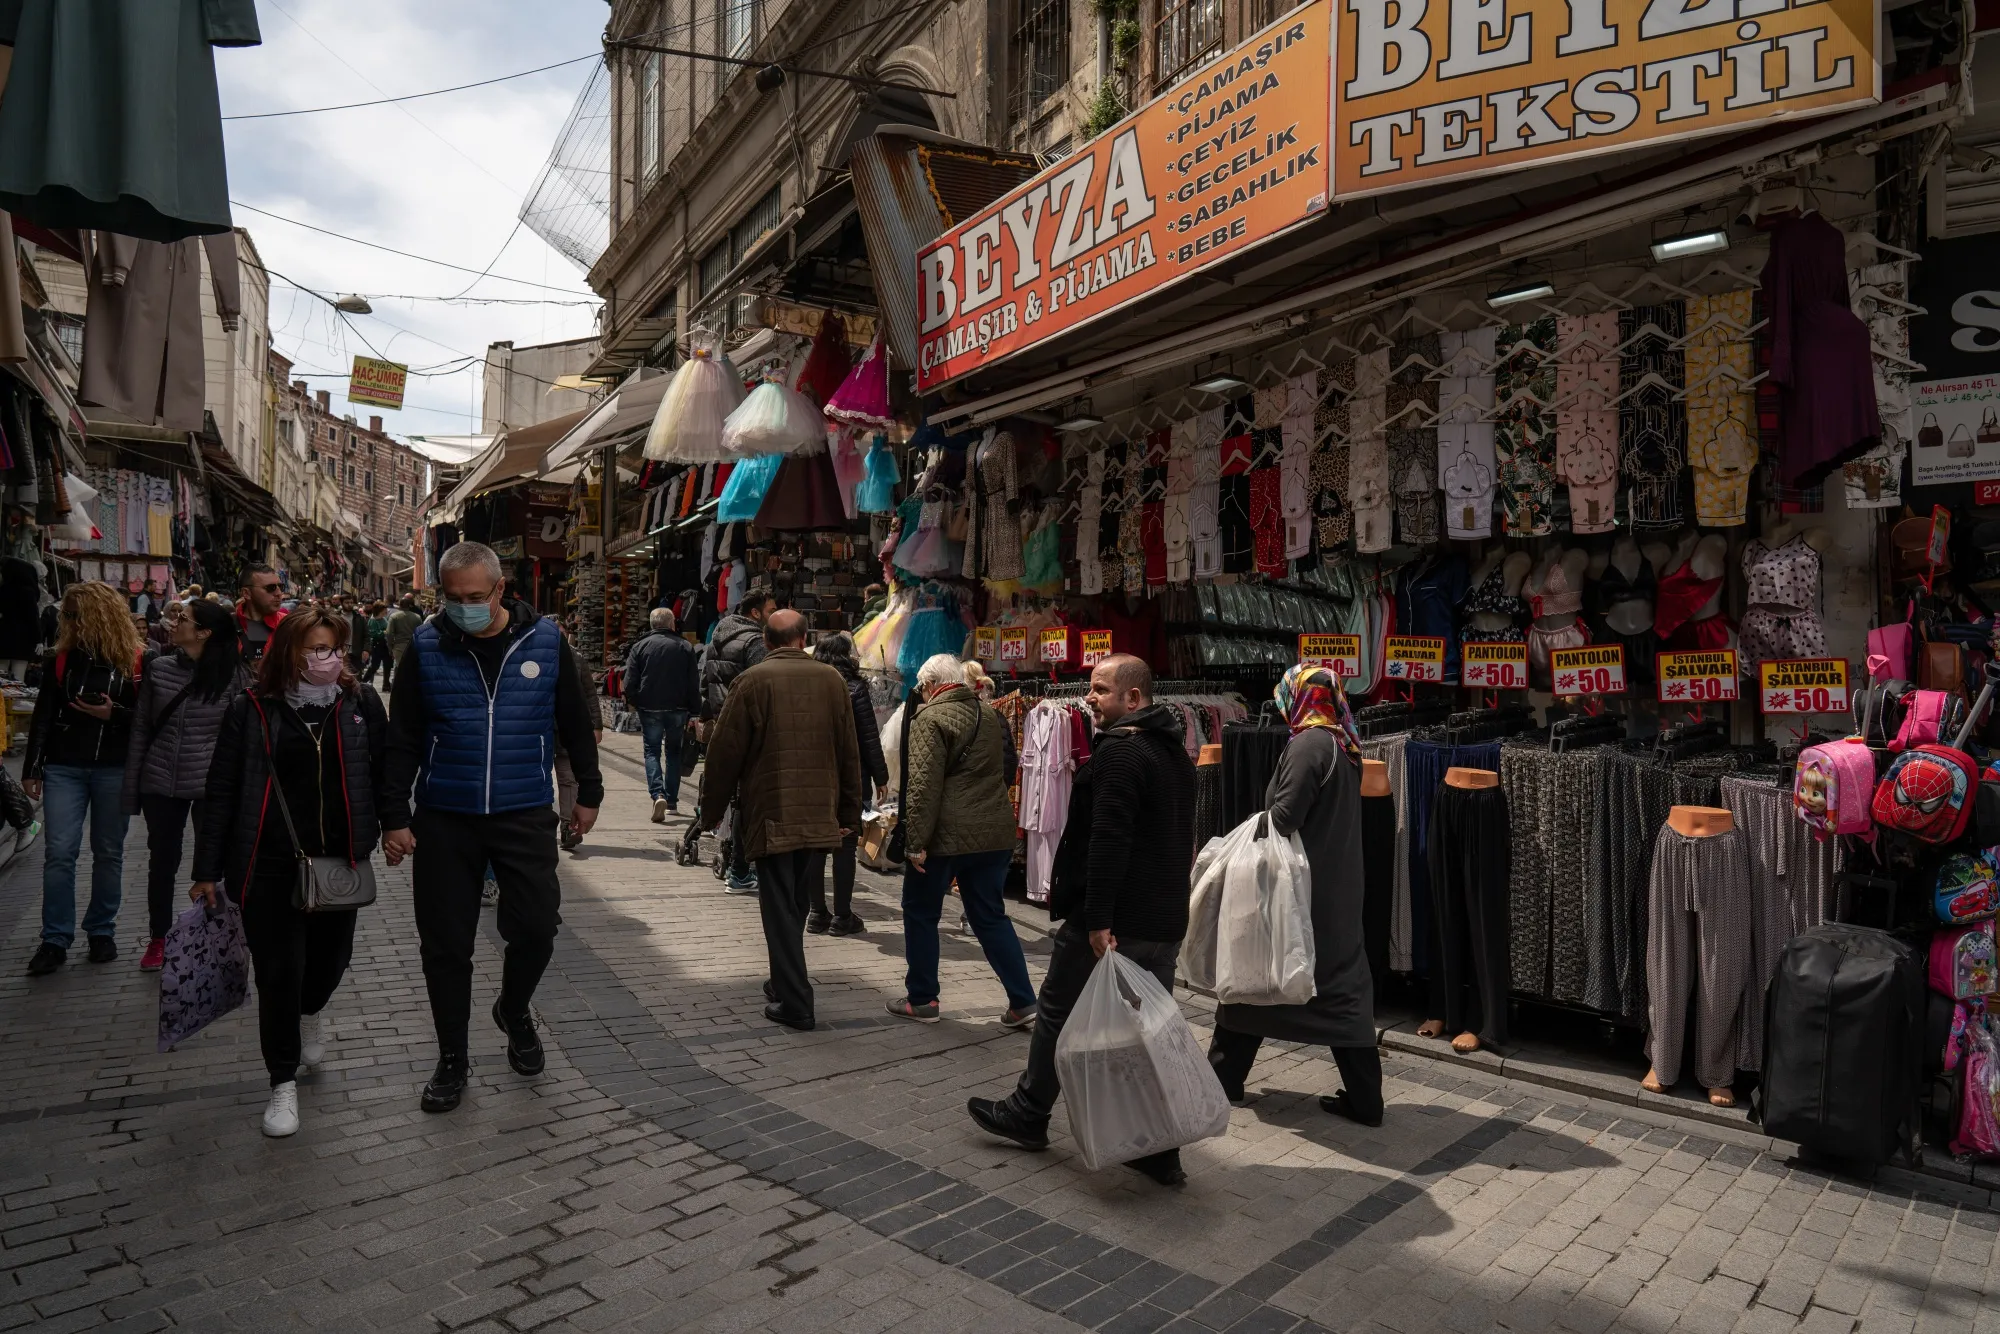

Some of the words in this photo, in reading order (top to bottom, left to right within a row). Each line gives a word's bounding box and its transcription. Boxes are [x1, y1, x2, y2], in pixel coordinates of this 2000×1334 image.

[1177, 21, 1307, 116] ÇAMAŞIR
[1350, 20, 1855, 178] TEKSTİL
[1176, 71, 1281, 146] PİJAMA
[1176, 114, 1258, 178] ÇEYİZ
[1176, 122, 1300, 205] GECELİK
[1176, 143, 1322, 235] SABAHLIK
[920, 125, 1157, 336] BEYZA
[1177, 216, 1247, 266] BEBE
[921, 302, 1018, 379] ÇAMAŞIR
[1024, 290, 1043, 326] &
[1048, 231, 1157, 315] PİJAMA
[368, 360, 392, 370] RİYAD
[1921, 386, 1933, 394] Ne
[1936, 383, 1968, 394] Alırsan
[1970, 380, 1982, 390] 45
[1985, 378, 1997, 388] TL
[1918, 466, 1933, 474] Bags
[1934, 464, 1962, 472] Anything
[1971, 460, 1994, 468] Turkish
[1003, 630, 1024, 640] PANTOLON
[1088, 632, 1107, 640] BAYAN
[1308, 636, 1354, 646] İSTANBUL
[1390, 638, 1442, 648] ANADOLU
[1010, 640, 1020, 656] 75
[1048, 642, 1060, 658] 50
[1084, 640, 1110, 650] PİJAMA
[1302, 646, 1356, 658] ŞALVAR
[1468, 646, 1525, 660] PANTOLON
[1393, 650, 1436, 660] ŞALVAR
[1556, 648, 1620, 666] PANTOLON
[1672, 653, 1726, 664] İSTANBUL
[1405, 662, 1424, 680] 75
[1486, 663, 1514, 686] 50
[1666, 663, 1732, 678] ŞALVAR
[1776, 662, 1836, 672] İSTANBUL
[1578, 668, 1610, 692] 50
[1768, 672, 1842, 688] ŞALVAR
[1690, 678, 1722, 700] 50
[1794, 688, 1830, 712] 50
